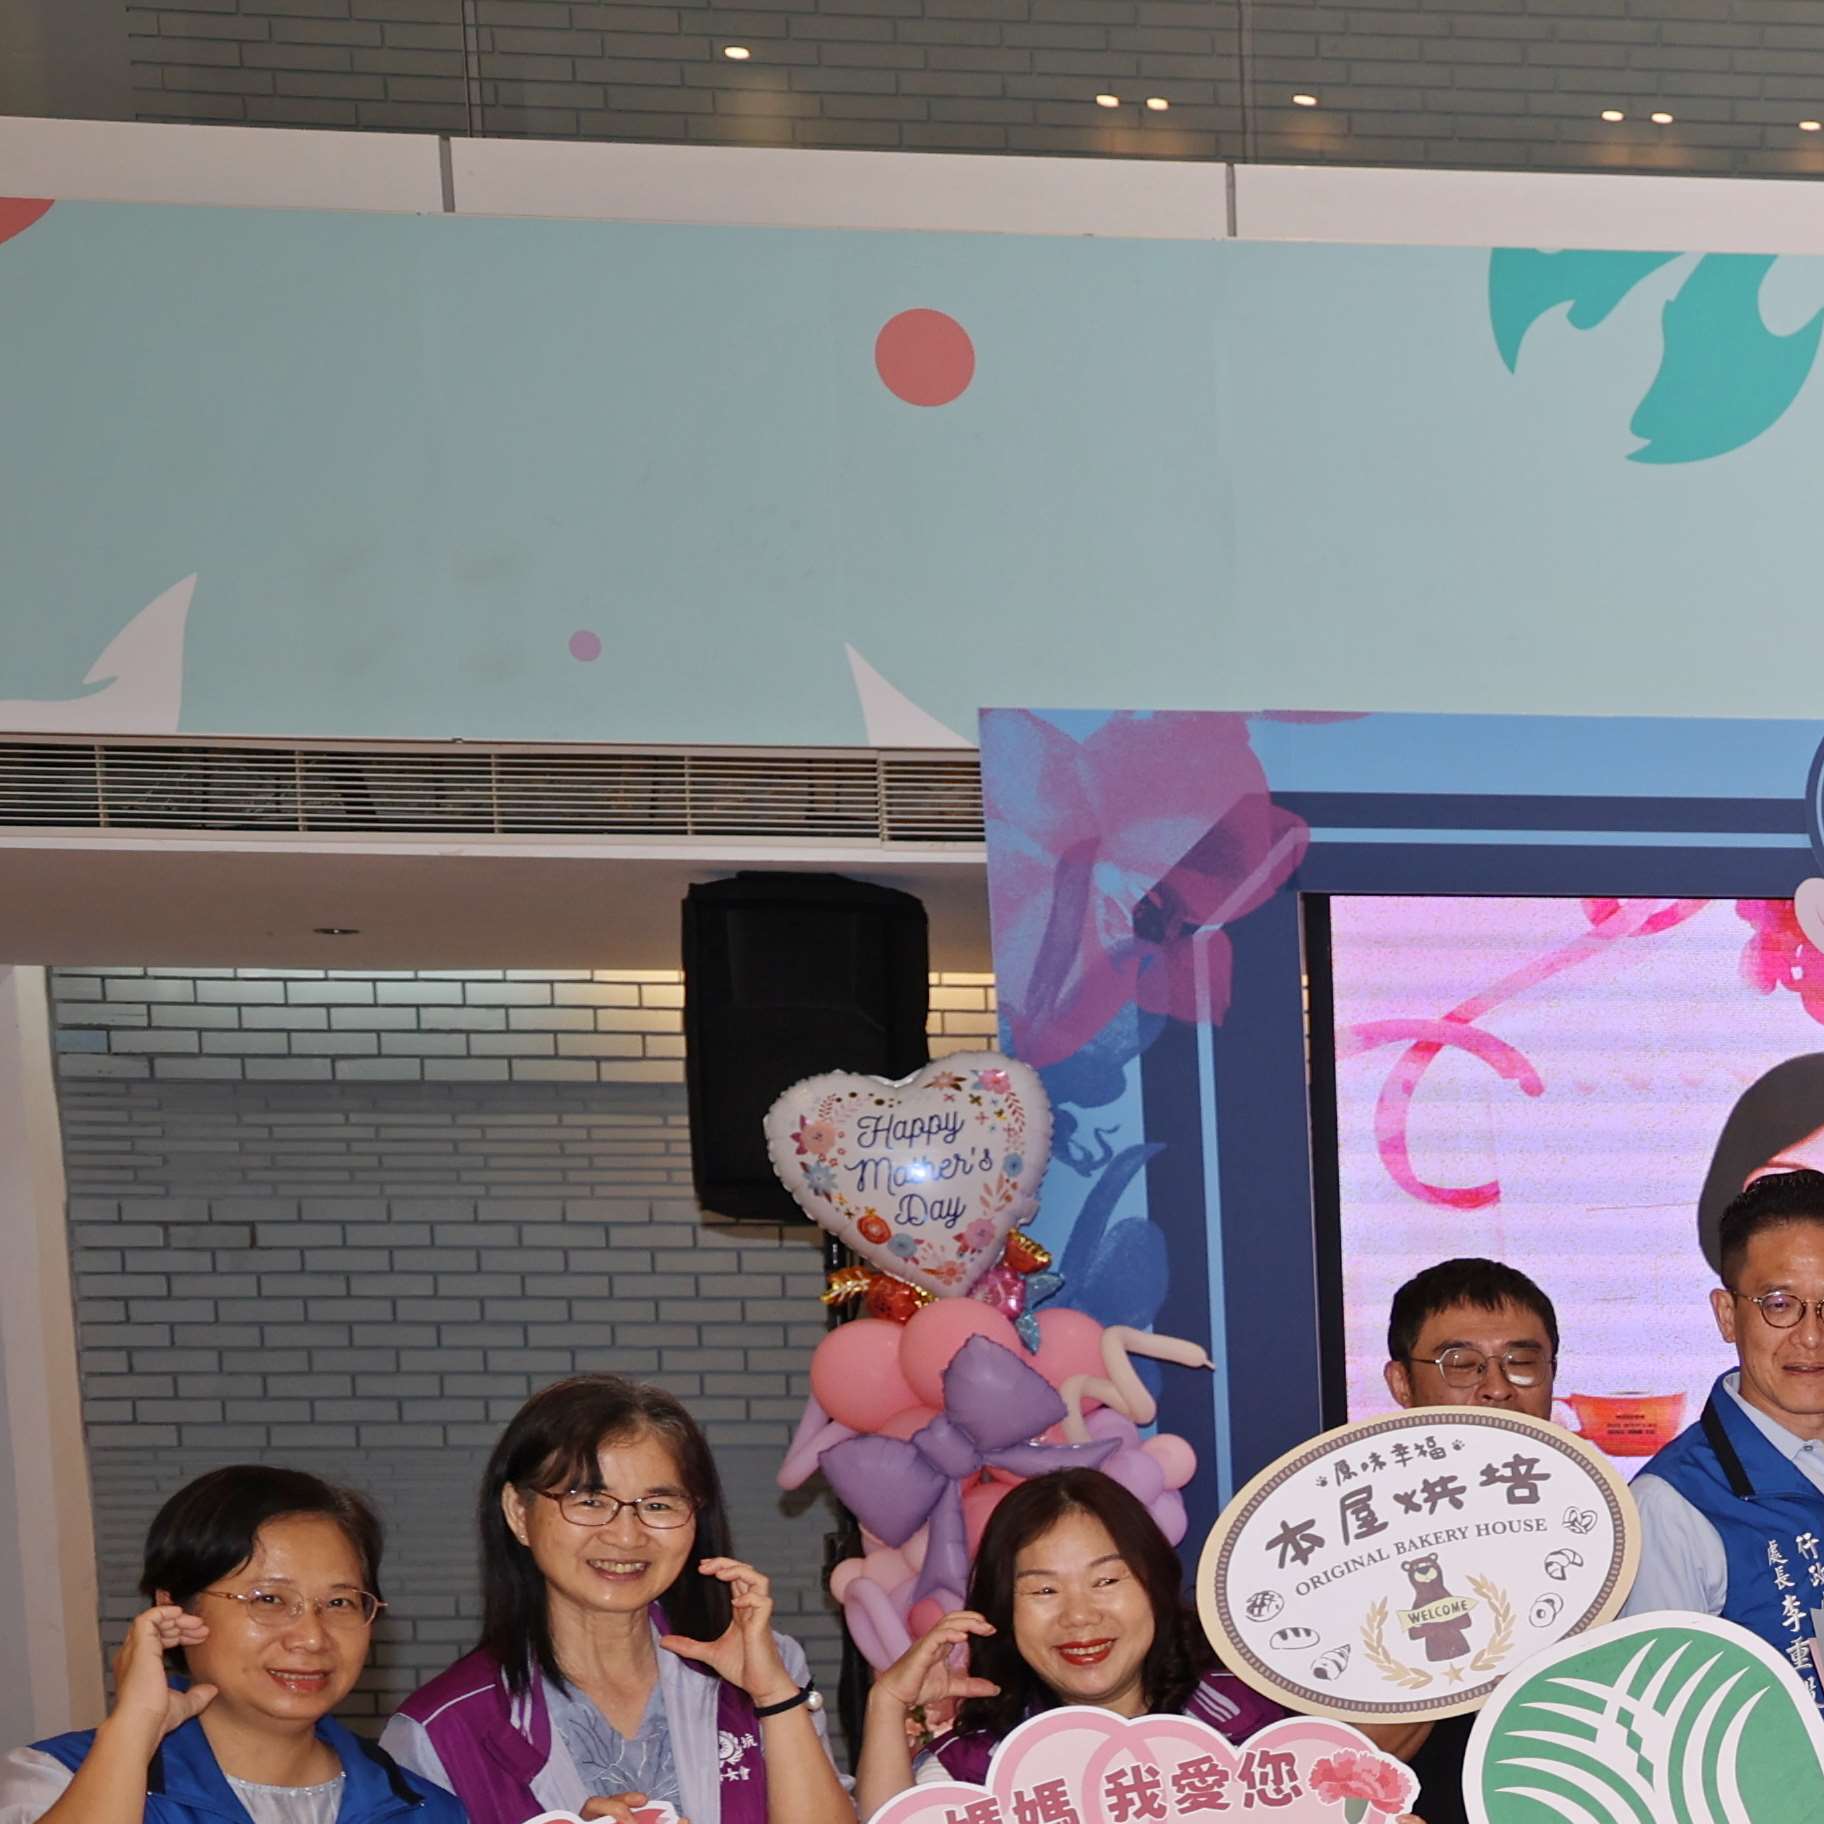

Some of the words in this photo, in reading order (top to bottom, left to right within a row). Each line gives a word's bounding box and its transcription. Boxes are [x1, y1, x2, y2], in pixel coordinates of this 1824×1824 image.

[857, 1109, 964, 1149] Happy
[845, 1148, 995, 1193] Mother's
[896, 1193, 967, 1231] Day
[1295, 1548, 1389, 1598] ORIGINAL
[1394, 1526, 1471, 1557] BAKERY
[1476, 1518, 1548, 1538] HOUSE
[1407, 1599, 1469, 1626] WELCOME
[1104, 1750, 1302, 1822] 我愛您
